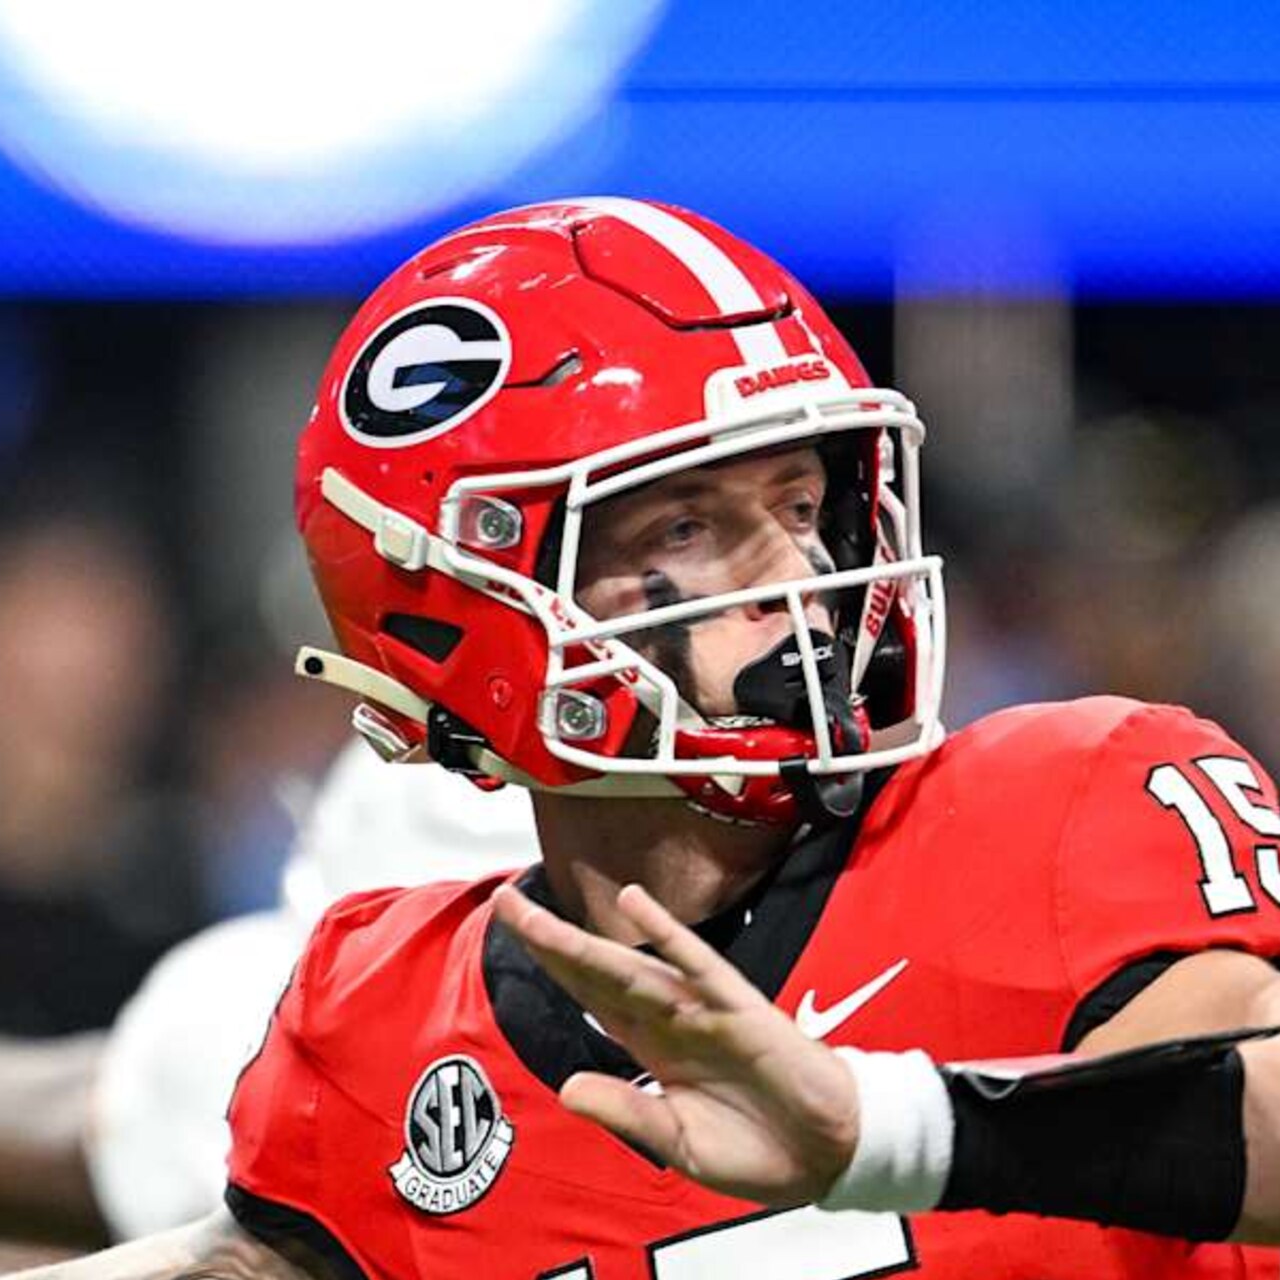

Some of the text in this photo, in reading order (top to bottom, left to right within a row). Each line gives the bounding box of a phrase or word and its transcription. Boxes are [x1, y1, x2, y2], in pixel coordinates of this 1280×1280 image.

[339, 299, 508, 445] G
[734, 360, 831, 399] DAWGS
[409, 1062, 493, 1175] SEC
[402, 1149, 500, 1211] GRADUATE
